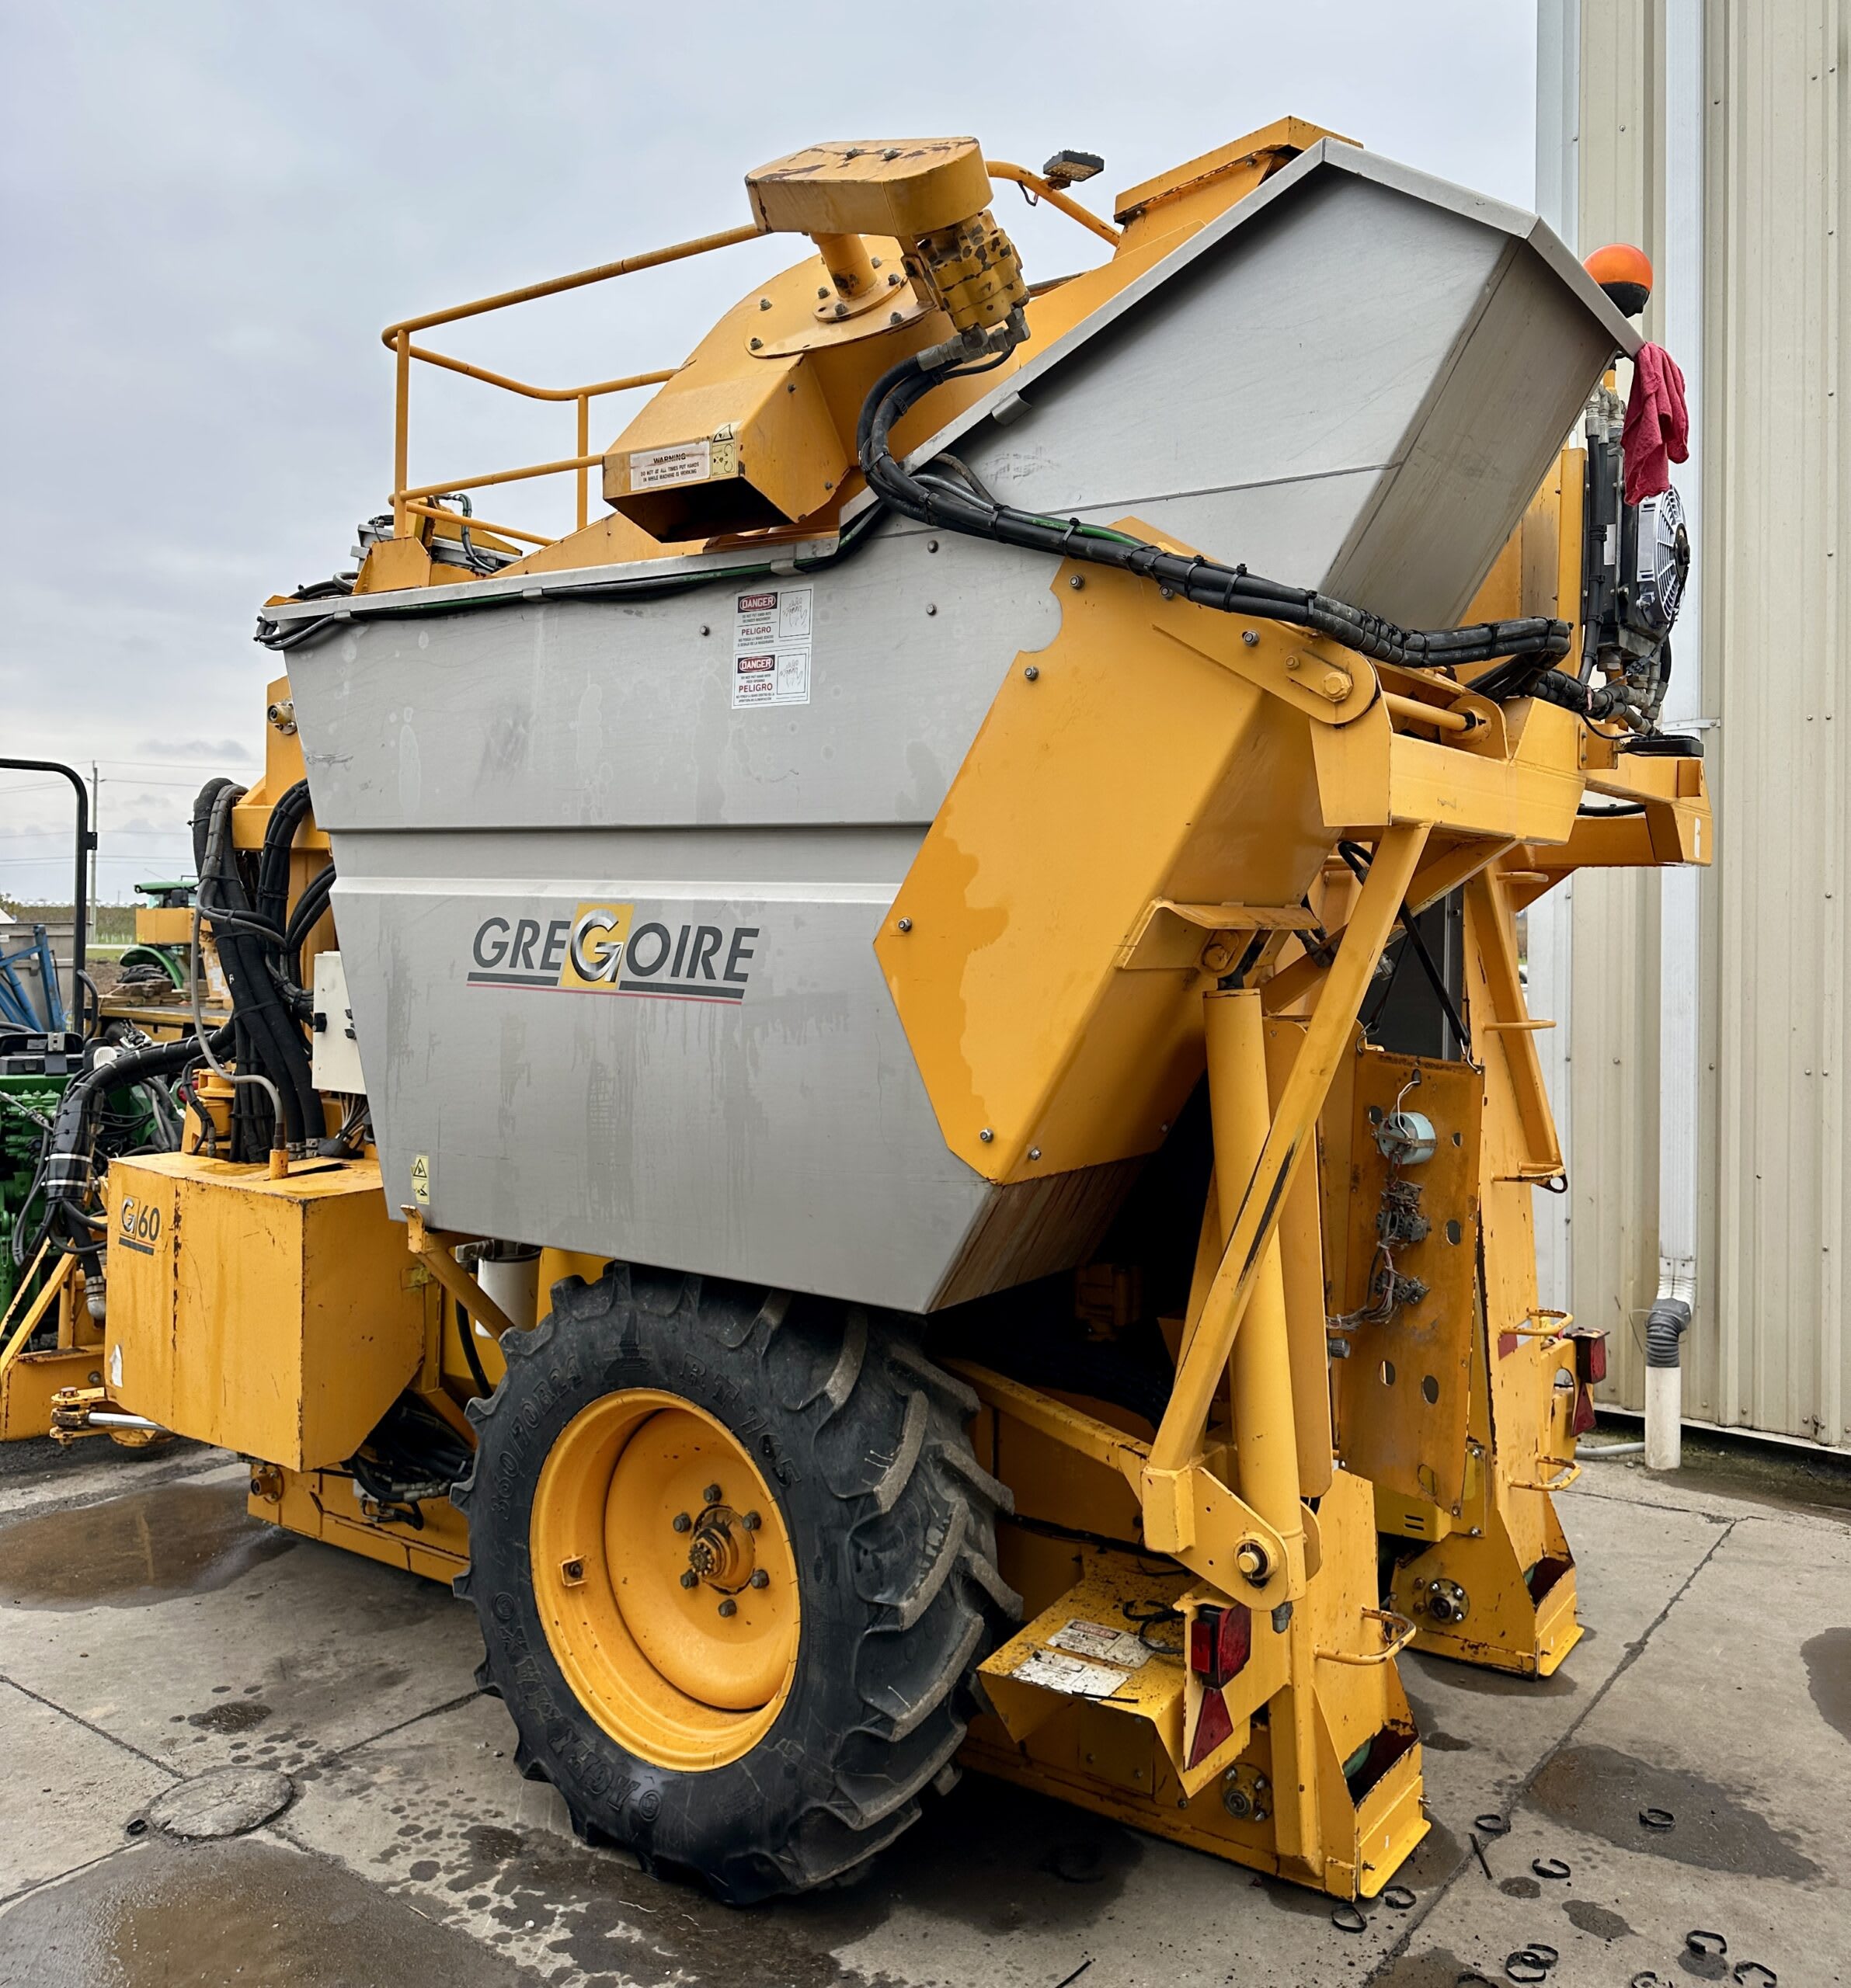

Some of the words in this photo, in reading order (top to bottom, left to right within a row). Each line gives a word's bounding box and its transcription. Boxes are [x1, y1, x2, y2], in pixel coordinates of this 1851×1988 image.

[653, 453, 686, 464] WARNING
[742, 596, 774, 609] DANGER
[741, 626, 771, 635] PELIGRO
[741, 659, 771, 669] DANGER
[739, 683, 773, 693] PELIGRO
[473, 909, 760, 983] GREGOIRE
